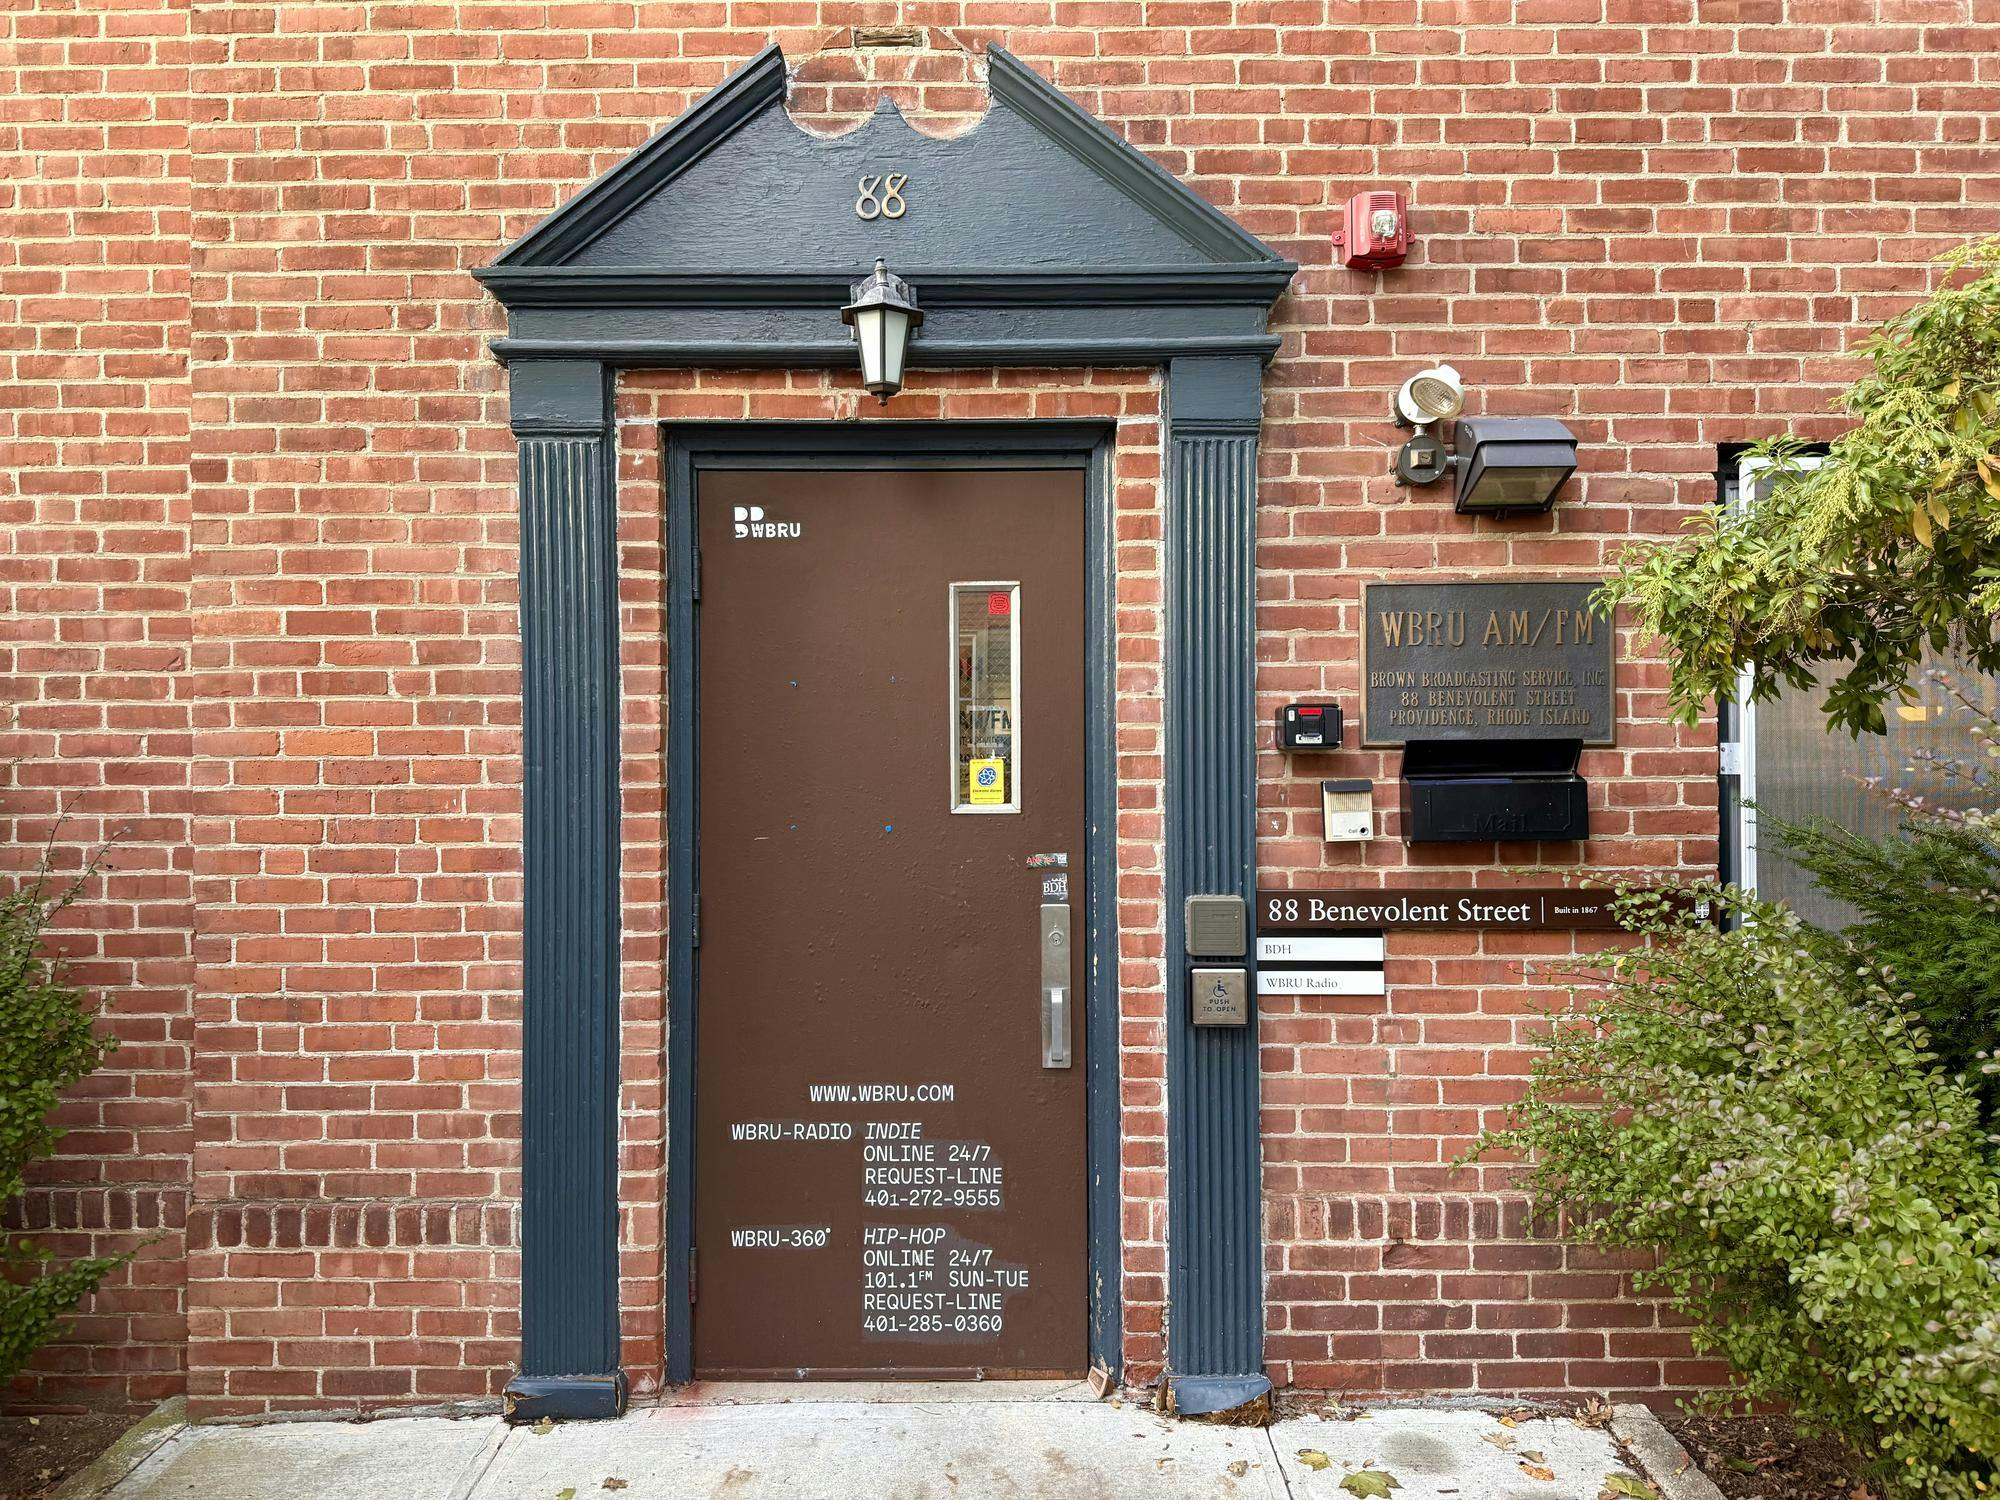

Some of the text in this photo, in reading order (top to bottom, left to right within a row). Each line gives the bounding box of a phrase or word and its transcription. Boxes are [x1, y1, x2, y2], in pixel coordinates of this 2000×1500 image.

[855, 172, 909, 220] 88
[751, 523, 800, 537] WBRU
[1381, 609, 1594, 648] WBRU AM/FM
[1371, 671, 1415, 688] BROWN
[1422, 671, 1516, 688] BROADCASTING
[1400, 690, 1576, 707] 88 BENEVOLENT STREET
[1390, 709, 1591, 727] PROVIDENCE, RHODE ISLAND
[1043, 881, 1066, 893] BDH
[1269, 898, 1530, 921] 88 Benevolent Street
[1554, 906, 1598, 914] Built in 1867
[1265, 944, 1291, 955] BDH
[1266, 977, 1338, 988] WBRU Radio
[810, 1085, 953, 1101] WWW.WBRU.COM
[732, 1123, 921, 1140] WBRU-RADIO INDIE
[864, 1145, 990, 1161] ONLINE 24/7
[866, 1168, 1002, 1184] REQUEST-LINE
[865, 1190, 999, 1206] 401-272-9555
[864, 1228, 945, 1244] HIP-HOP
[864, 1250, 992, 1266] ONLINE 24/7
[949, 1271, 1028, 1287] SUN-TUE
[865, 1294, 1001, 1310] REQUEST-LINE
[864, 1315, 1002, 1331] 401-285-0360
